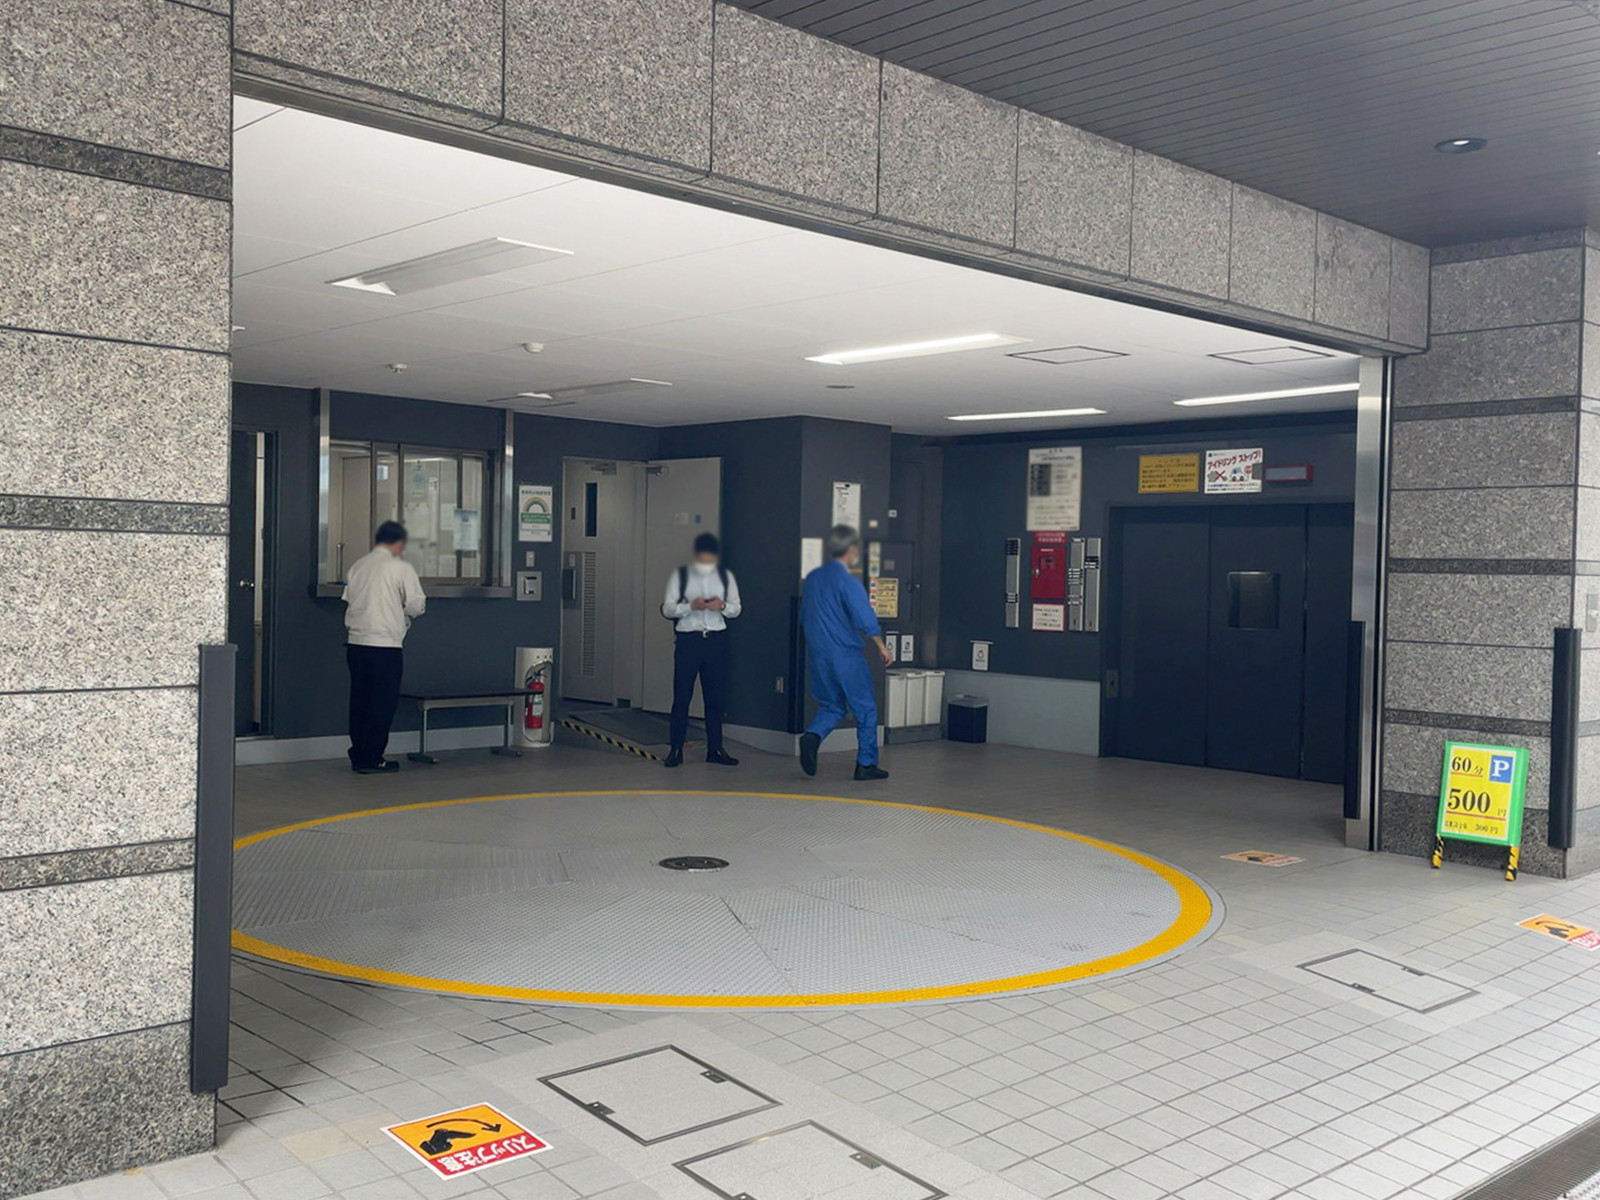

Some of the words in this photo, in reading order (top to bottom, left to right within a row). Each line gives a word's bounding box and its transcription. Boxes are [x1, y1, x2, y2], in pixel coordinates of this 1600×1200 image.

[1207, 456, 1237, 470] アイドリング
[1492, 760, 1509, 776] P
[437, 1135, 537, 1172] スリップ注意
